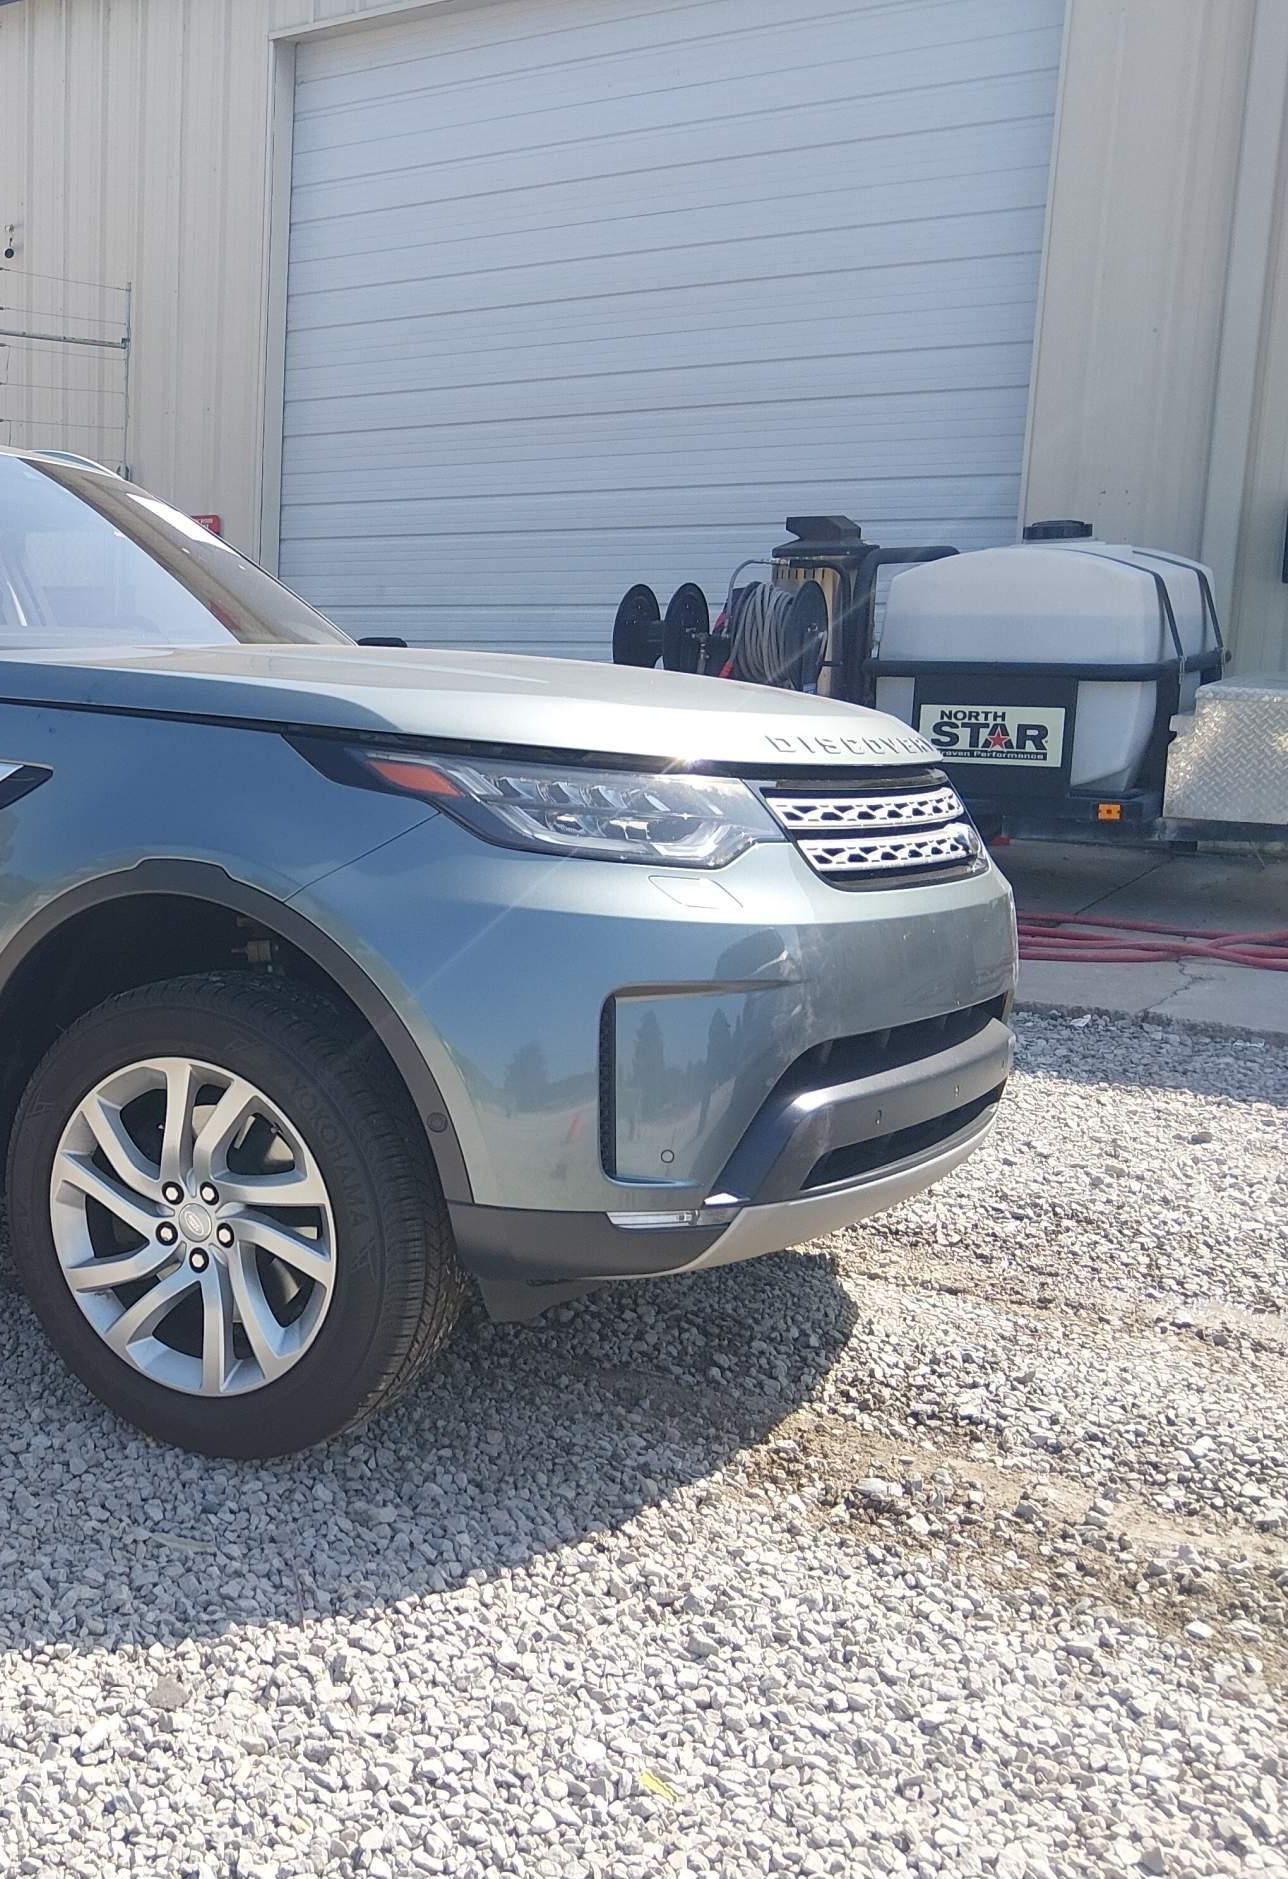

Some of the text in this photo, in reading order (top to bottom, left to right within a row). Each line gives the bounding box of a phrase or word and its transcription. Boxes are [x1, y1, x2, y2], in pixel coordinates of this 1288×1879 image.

[940, 710, 1006, 722] NORTH
[931, 721, 1049, 750] STAR
[974, 751, 1044, 760] Performance
